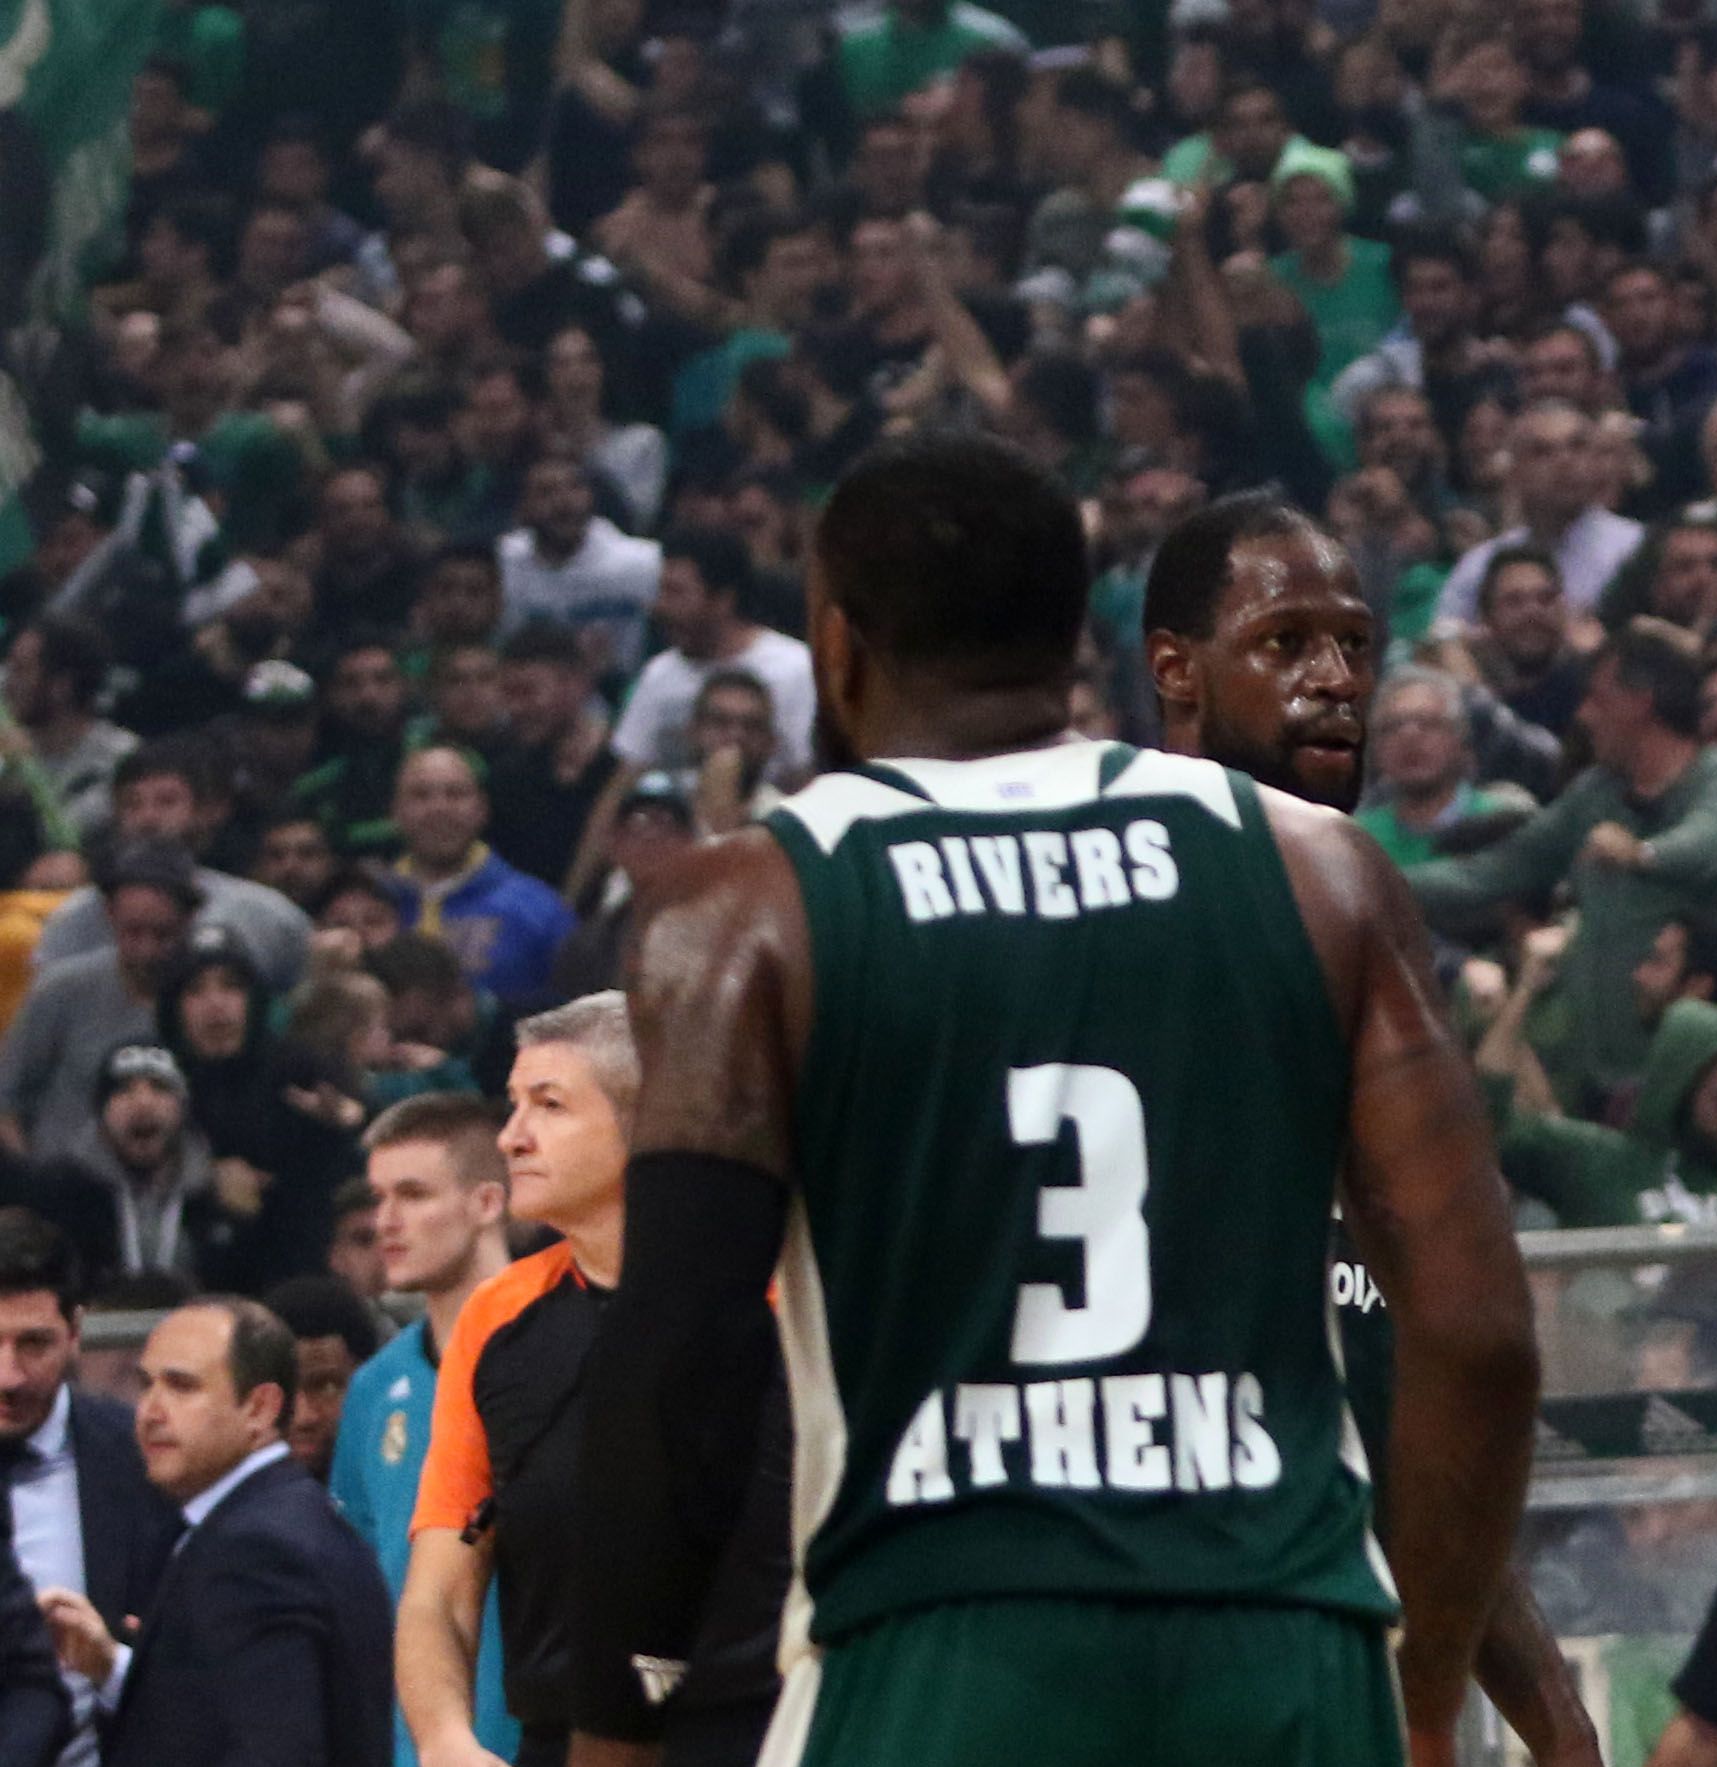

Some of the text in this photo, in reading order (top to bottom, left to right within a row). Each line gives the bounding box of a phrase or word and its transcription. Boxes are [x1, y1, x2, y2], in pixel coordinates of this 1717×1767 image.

[888, 819, 1180, 922] RIVERS
[1007, 1062, 1153, 1366] 3
[886, 1371, 1283, 1507] ATHENS
